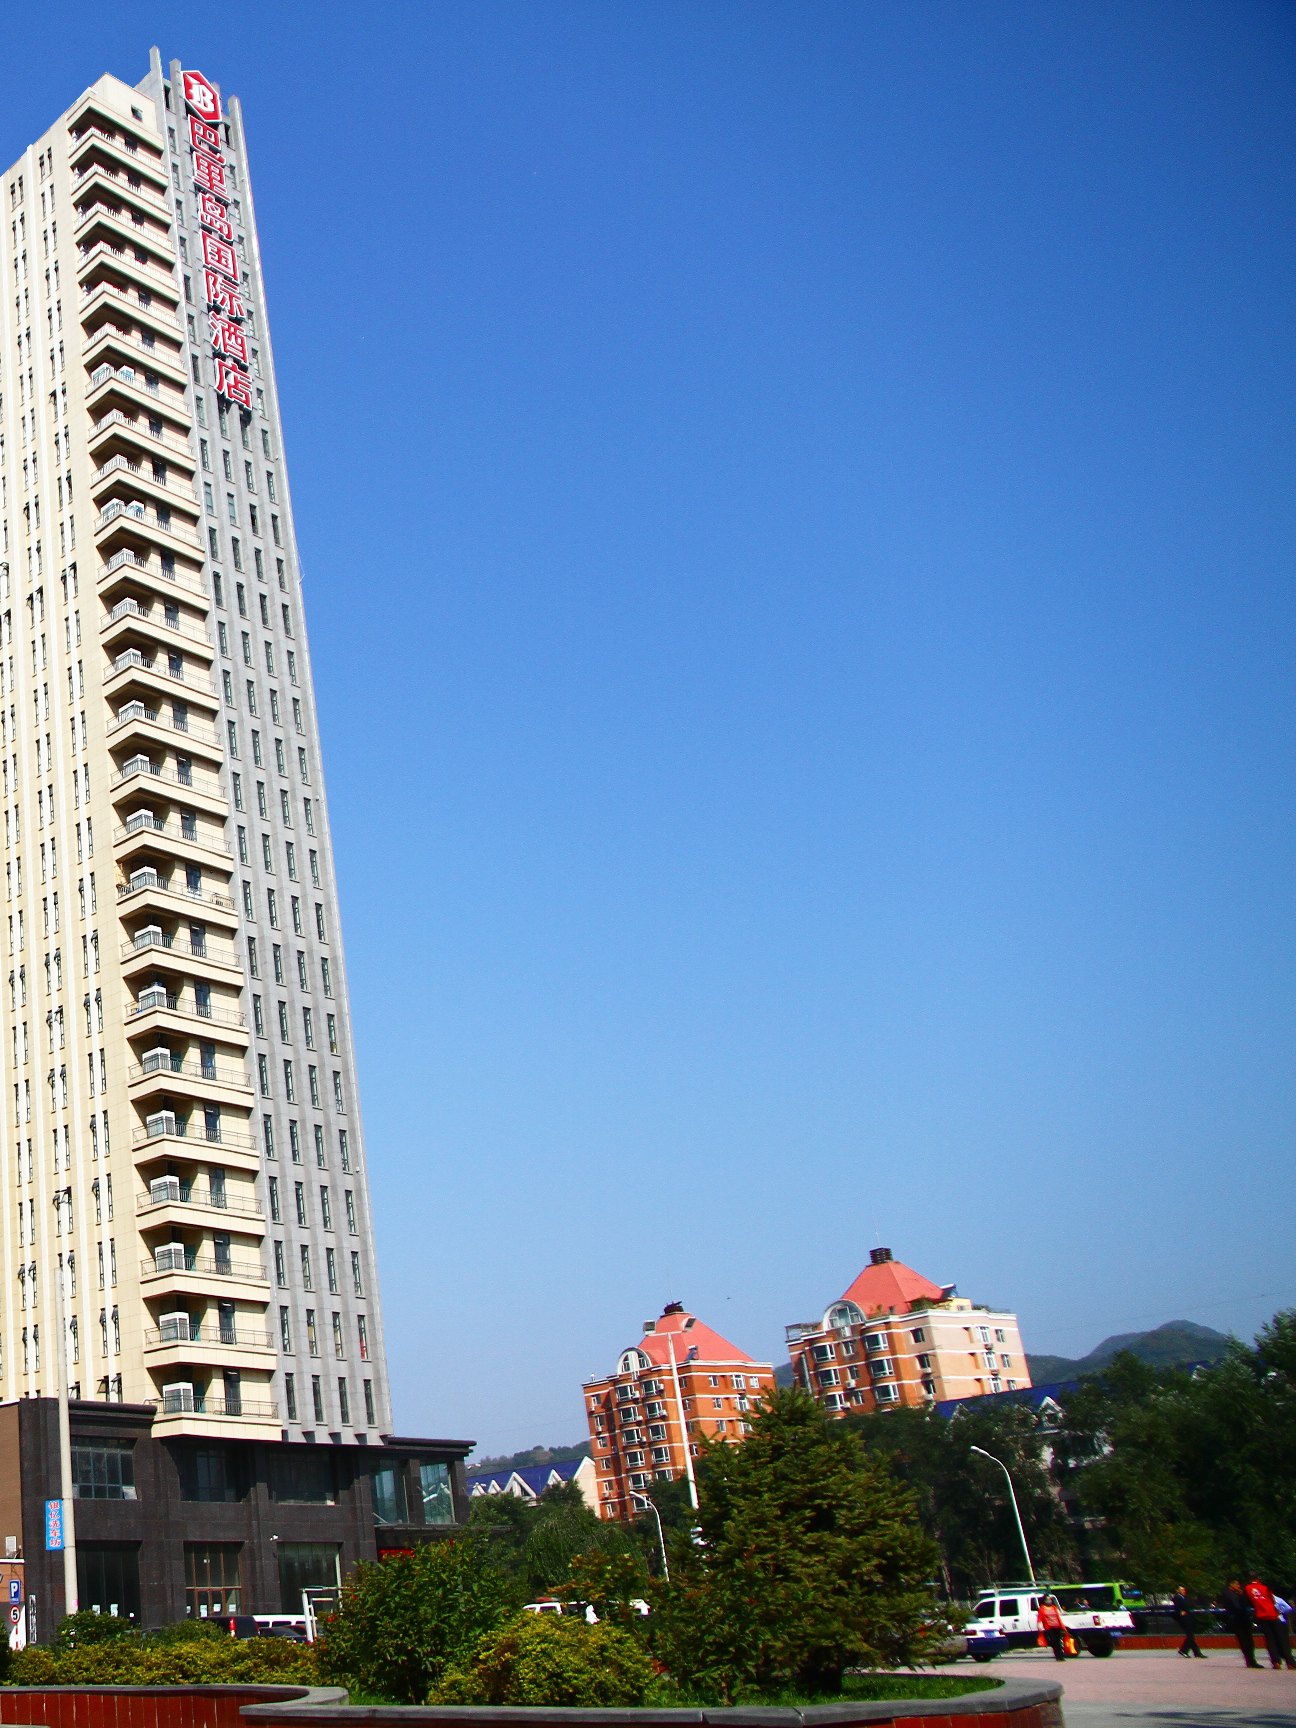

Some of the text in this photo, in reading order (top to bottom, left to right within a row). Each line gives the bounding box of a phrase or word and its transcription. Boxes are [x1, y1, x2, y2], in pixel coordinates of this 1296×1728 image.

[188, 114, 253, 410] 巴里岛国际酒店
[12, 1609, 19, 1621] 5
